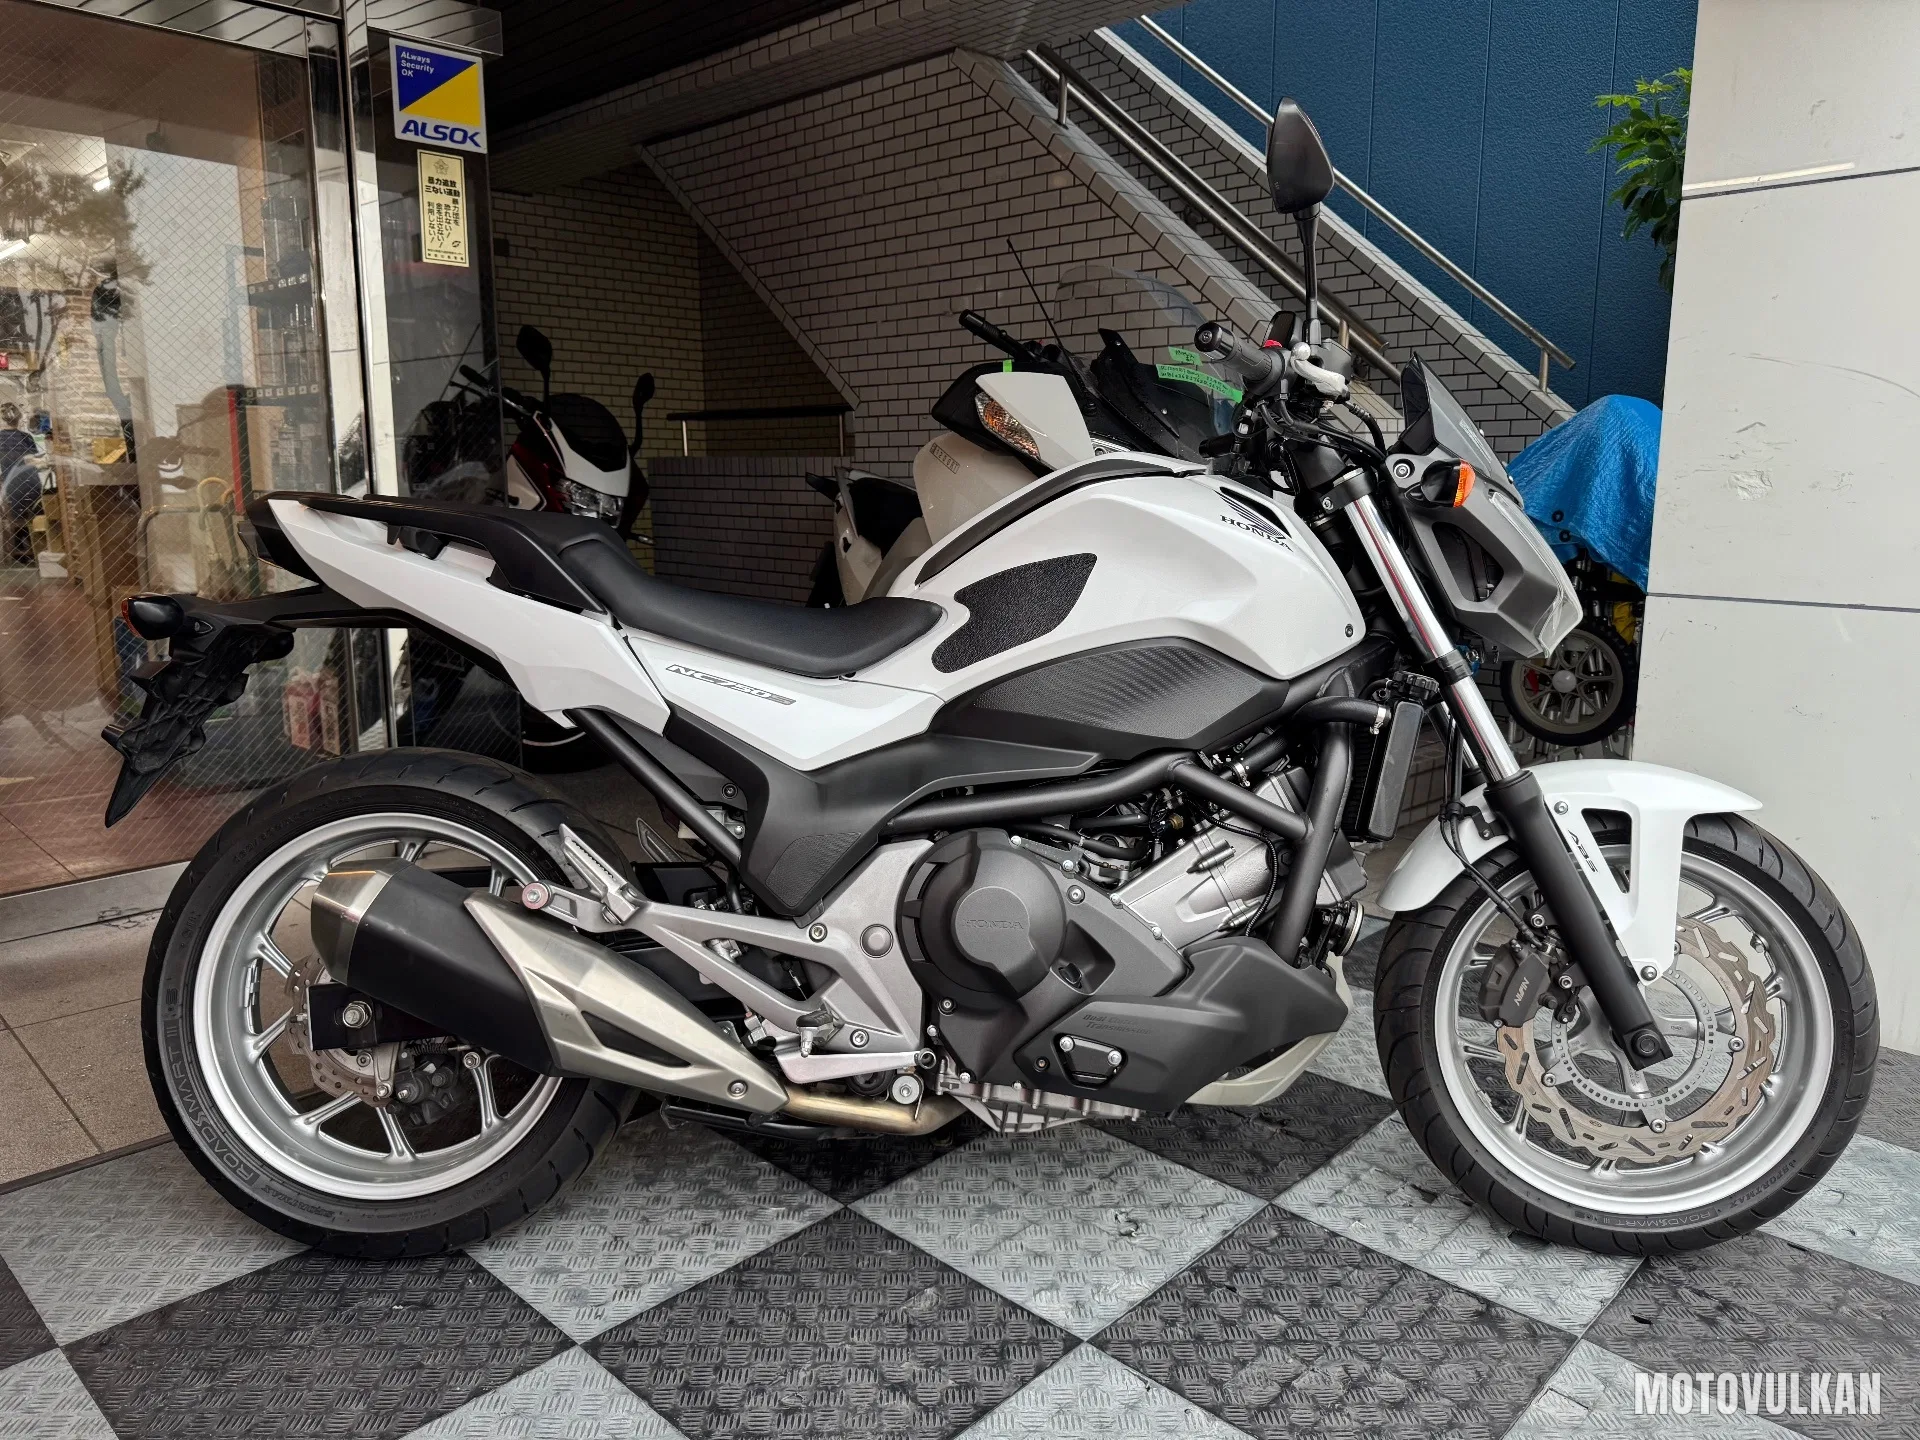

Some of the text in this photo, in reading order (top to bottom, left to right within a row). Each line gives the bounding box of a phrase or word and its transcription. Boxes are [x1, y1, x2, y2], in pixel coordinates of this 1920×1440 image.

[401, 51, 431, 64] ALways
[401, 60, 434, 74] Security
[401, 68, 414, 77] OK
[401, 119, 481, 148] ALSOK
[1220, 514, 1293, 552] HONDA
[1567, 829, 1599, 873] ABS
[963, 918, 1024, 930] HONDA
